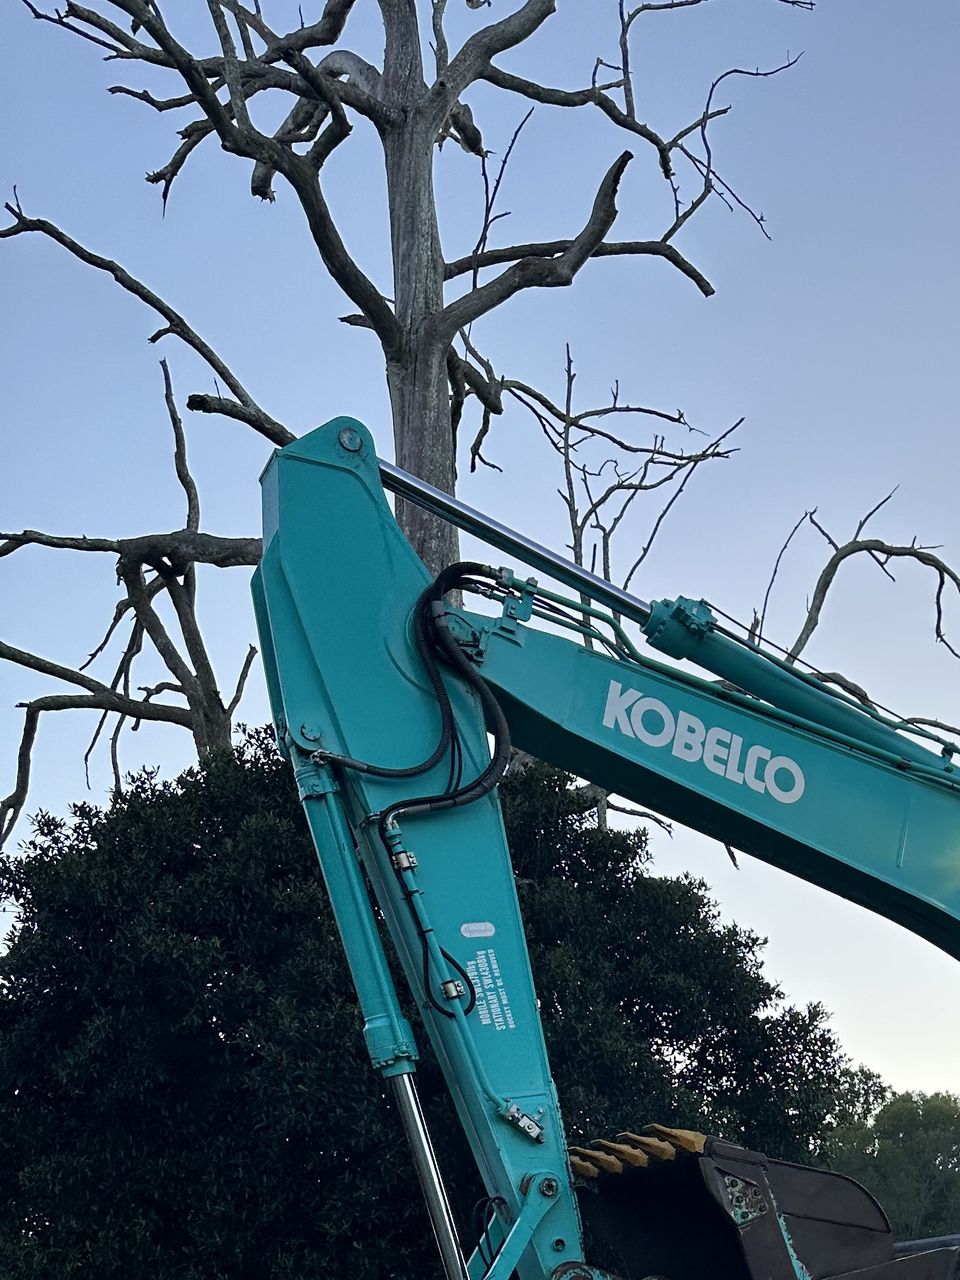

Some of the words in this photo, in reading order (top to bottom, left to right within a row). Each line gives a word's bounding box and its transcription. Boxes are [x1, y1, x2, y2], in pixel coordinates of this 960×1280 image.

[602, 679, 805, 804] KOBELCO
[487, 949, 501, 977] REMOVED
[498, 988, 509, 1005] MUST
[476, 1000, 492, 1025] MOBILE
[486, 991, 506, 1031] STATIONARY
[504, 1006, 516, 1029] BUCKET
